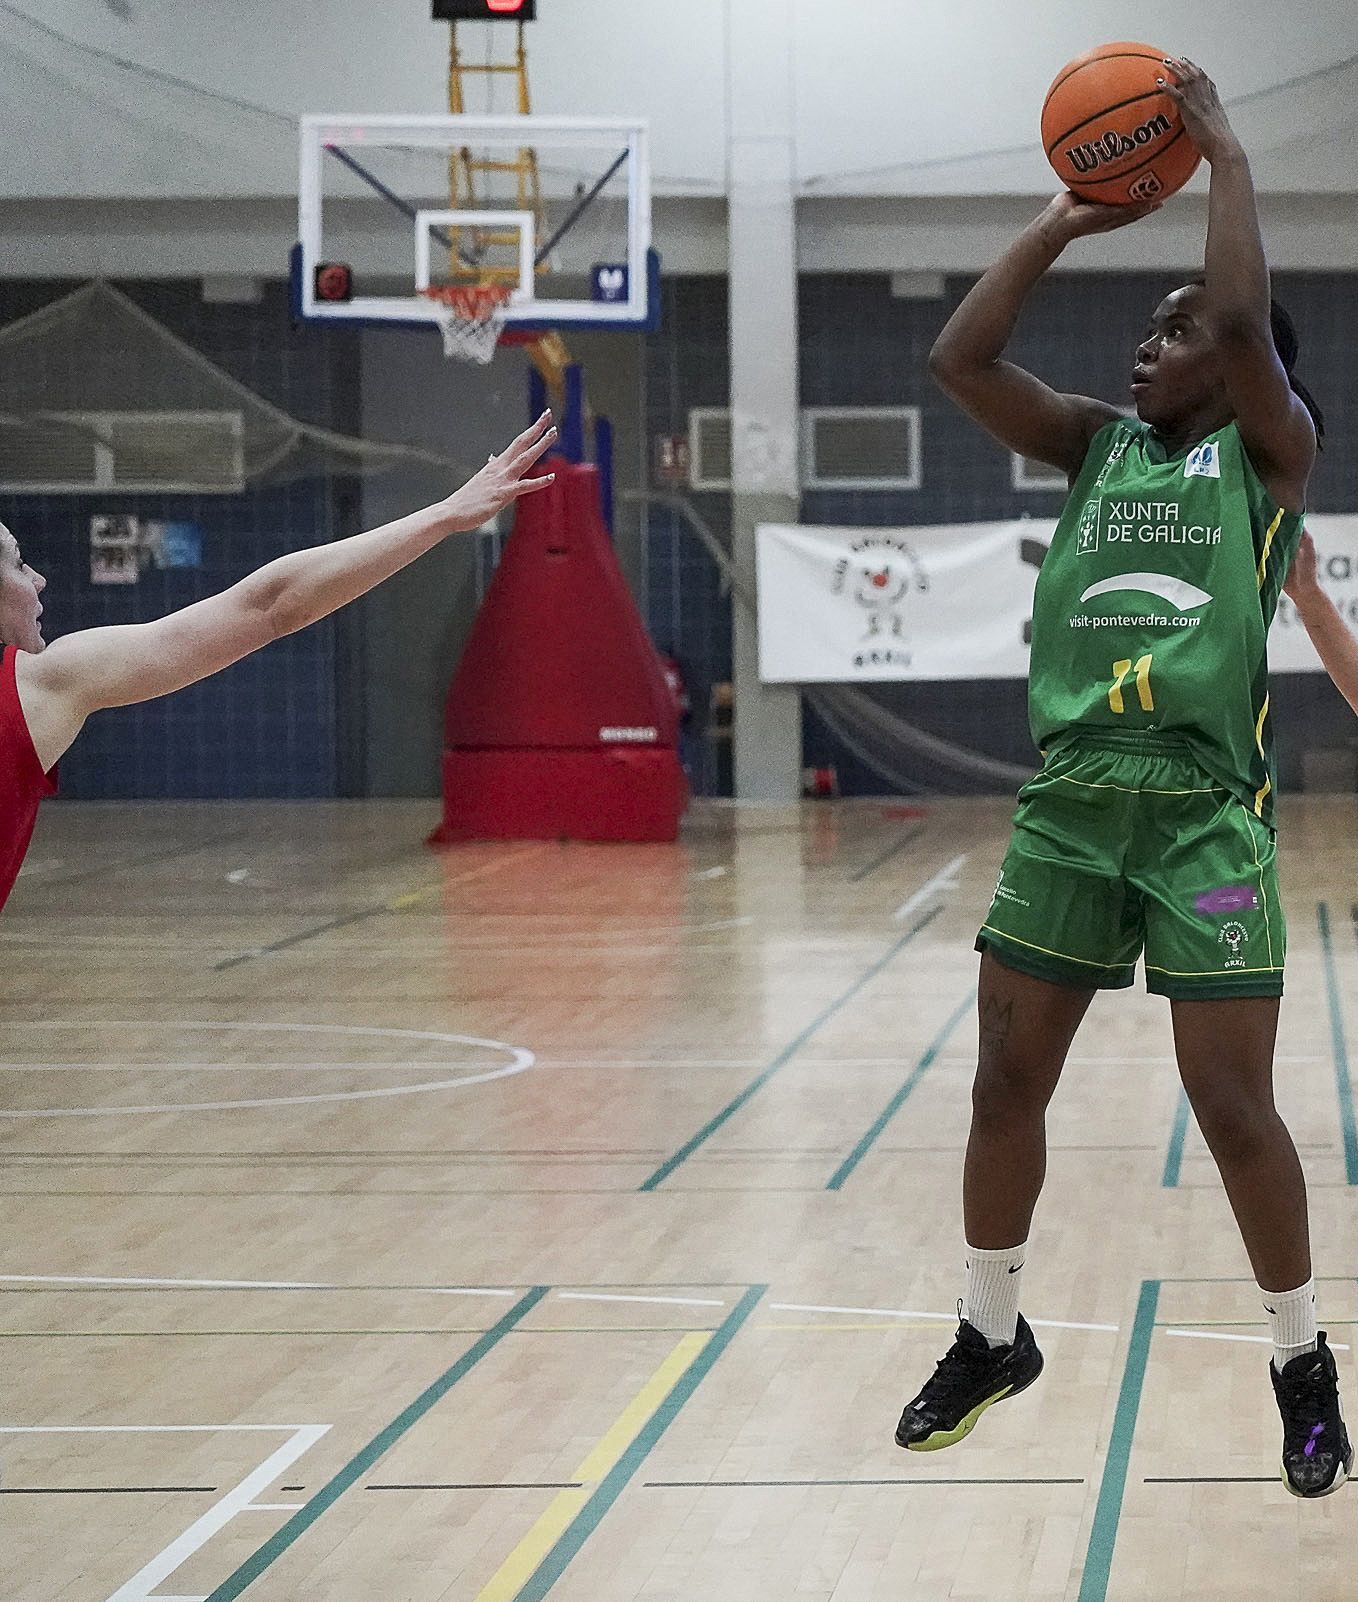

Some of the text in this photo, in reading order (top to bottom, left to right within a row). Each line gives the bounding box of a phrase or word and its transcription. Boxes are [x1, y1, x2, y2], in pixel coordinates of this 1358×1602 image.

[1065, 113, 1172, 173] Wilson
[1109, 502, 1179, 521] XUNTA
[1107, 524, 1222, 545] DE GALICIA
[1069, 613, 1201, 630] visit-pontevedra.com
[1108, 653, 1155, 714] 11
